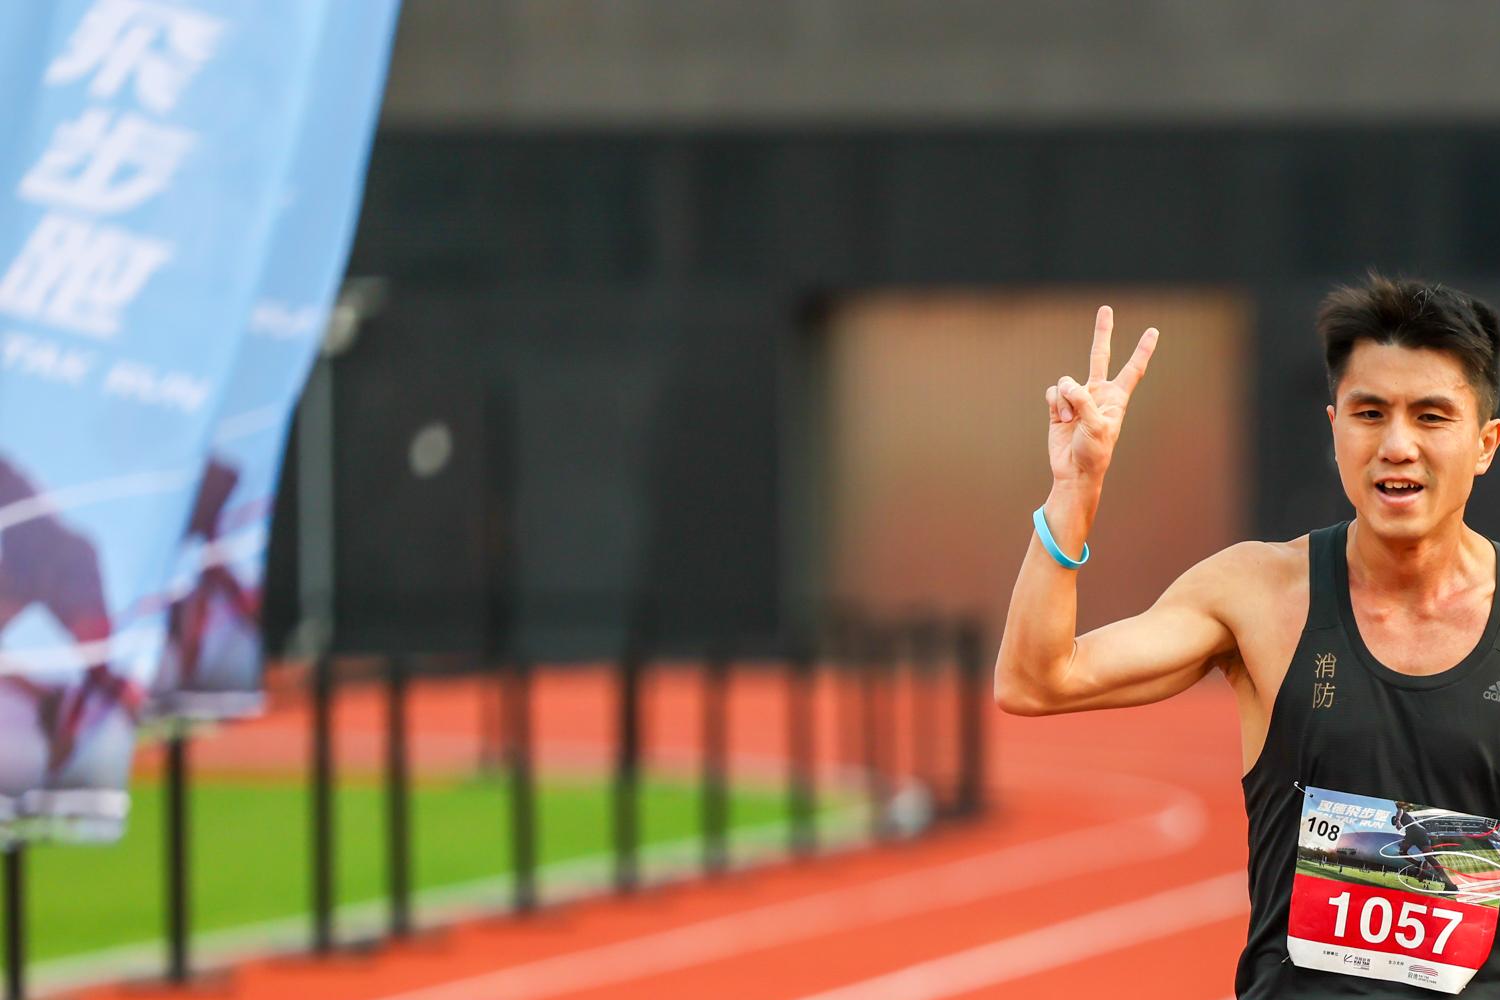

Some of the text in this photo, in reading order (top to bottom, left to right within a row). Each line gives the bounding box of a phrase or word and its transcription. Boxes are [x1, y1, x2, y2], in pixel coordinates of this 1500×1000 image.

[1312, 652, 1337, 709] 消防
[1308, 816, 1340, 841] 108
[1328, 891, 1464, 955] 1057
